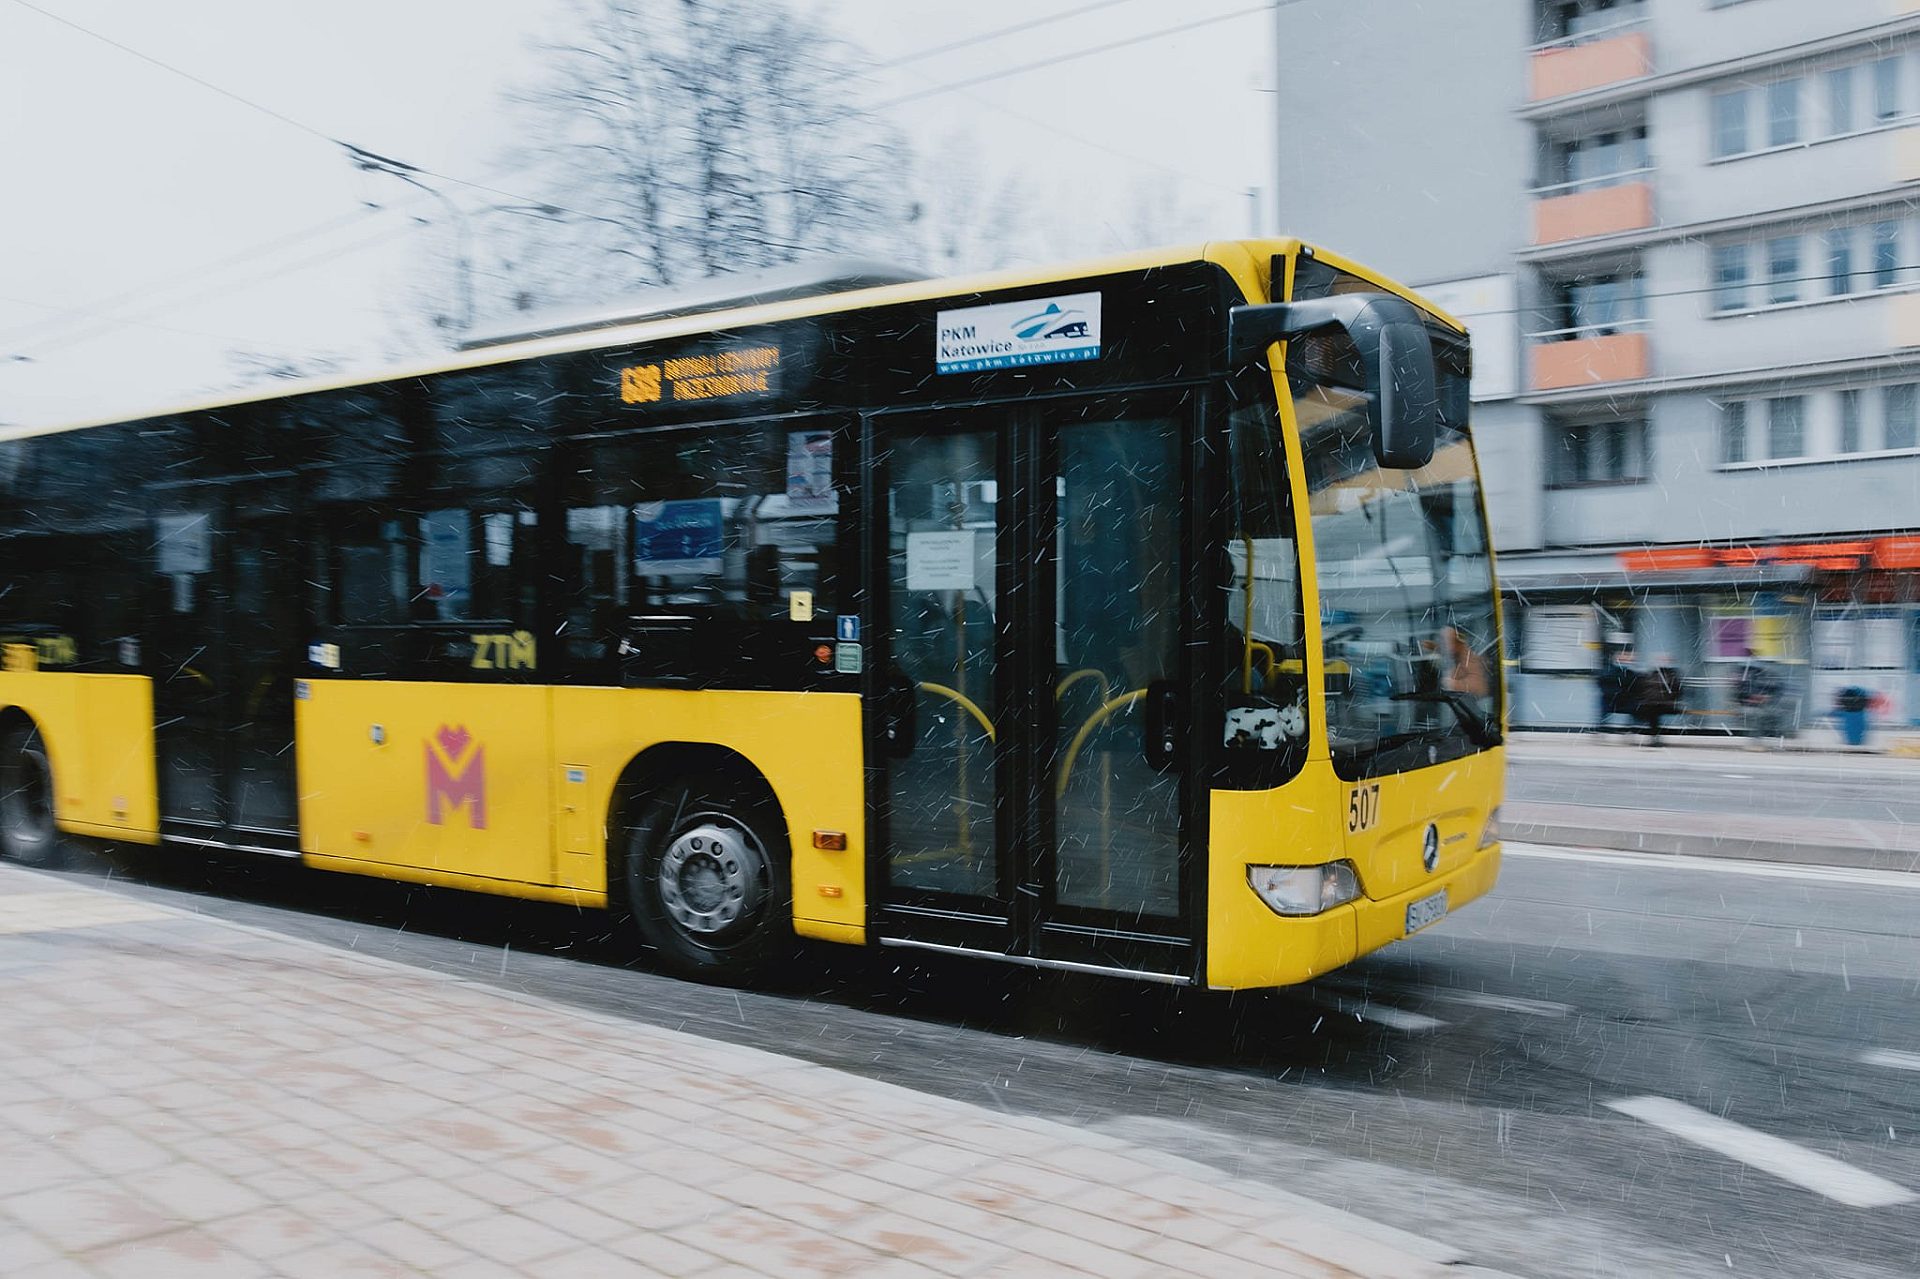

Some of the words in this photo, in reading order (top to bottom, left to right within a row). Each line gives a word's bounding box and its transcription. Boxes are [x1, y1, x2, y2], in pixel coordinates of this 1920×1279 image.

[941, 326, 976, 341] PKM
[941, 341, 1013, 358] Katowice
[471, 630, 537, 669] ZTM
[1349, 784, 1380, 832] 507
